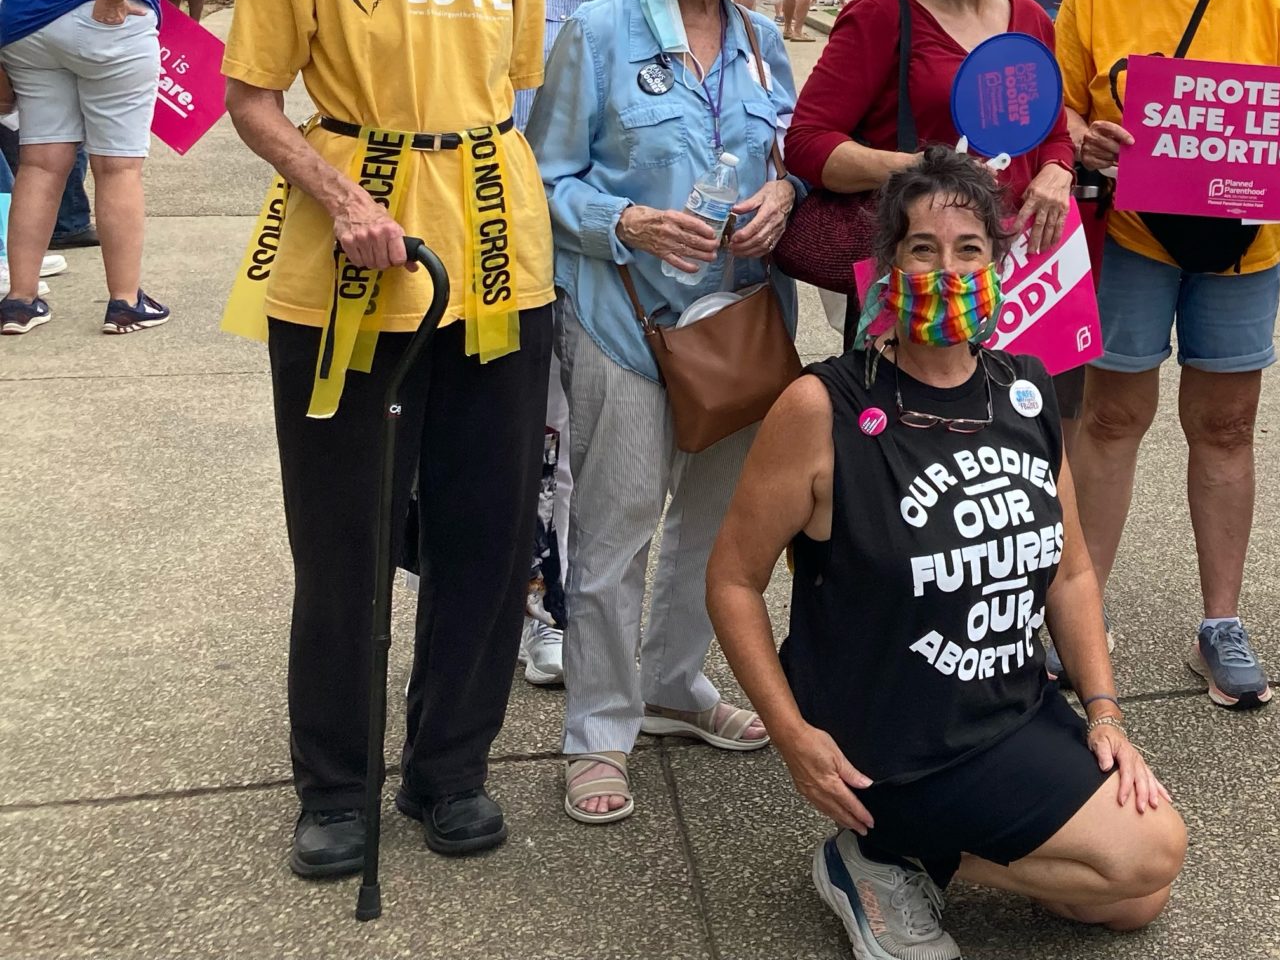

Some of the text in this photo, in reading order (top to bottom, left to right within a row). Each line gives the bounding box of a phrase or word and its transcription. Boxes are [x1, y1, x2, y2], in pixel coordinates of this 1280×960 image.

[159, 66, 195, 111] are.
[171, 54, 190, 75] is
[1004, 66, 1020, 121] BODIES
[1142, 102, 1235, 136] SAFE,
[1224, 186, 1266, 195] Parenthood
[1225, 179, 1254, 188] Planned
[466, 126, 511, 306] DO NOT CROSS
[900, 446, 1057, 528] OUR BODIES
[953, 489, 1035, 539] OUR
[910, 521, 1064, 597] FUTURES
[967, 589, 1035, 642] OUR
